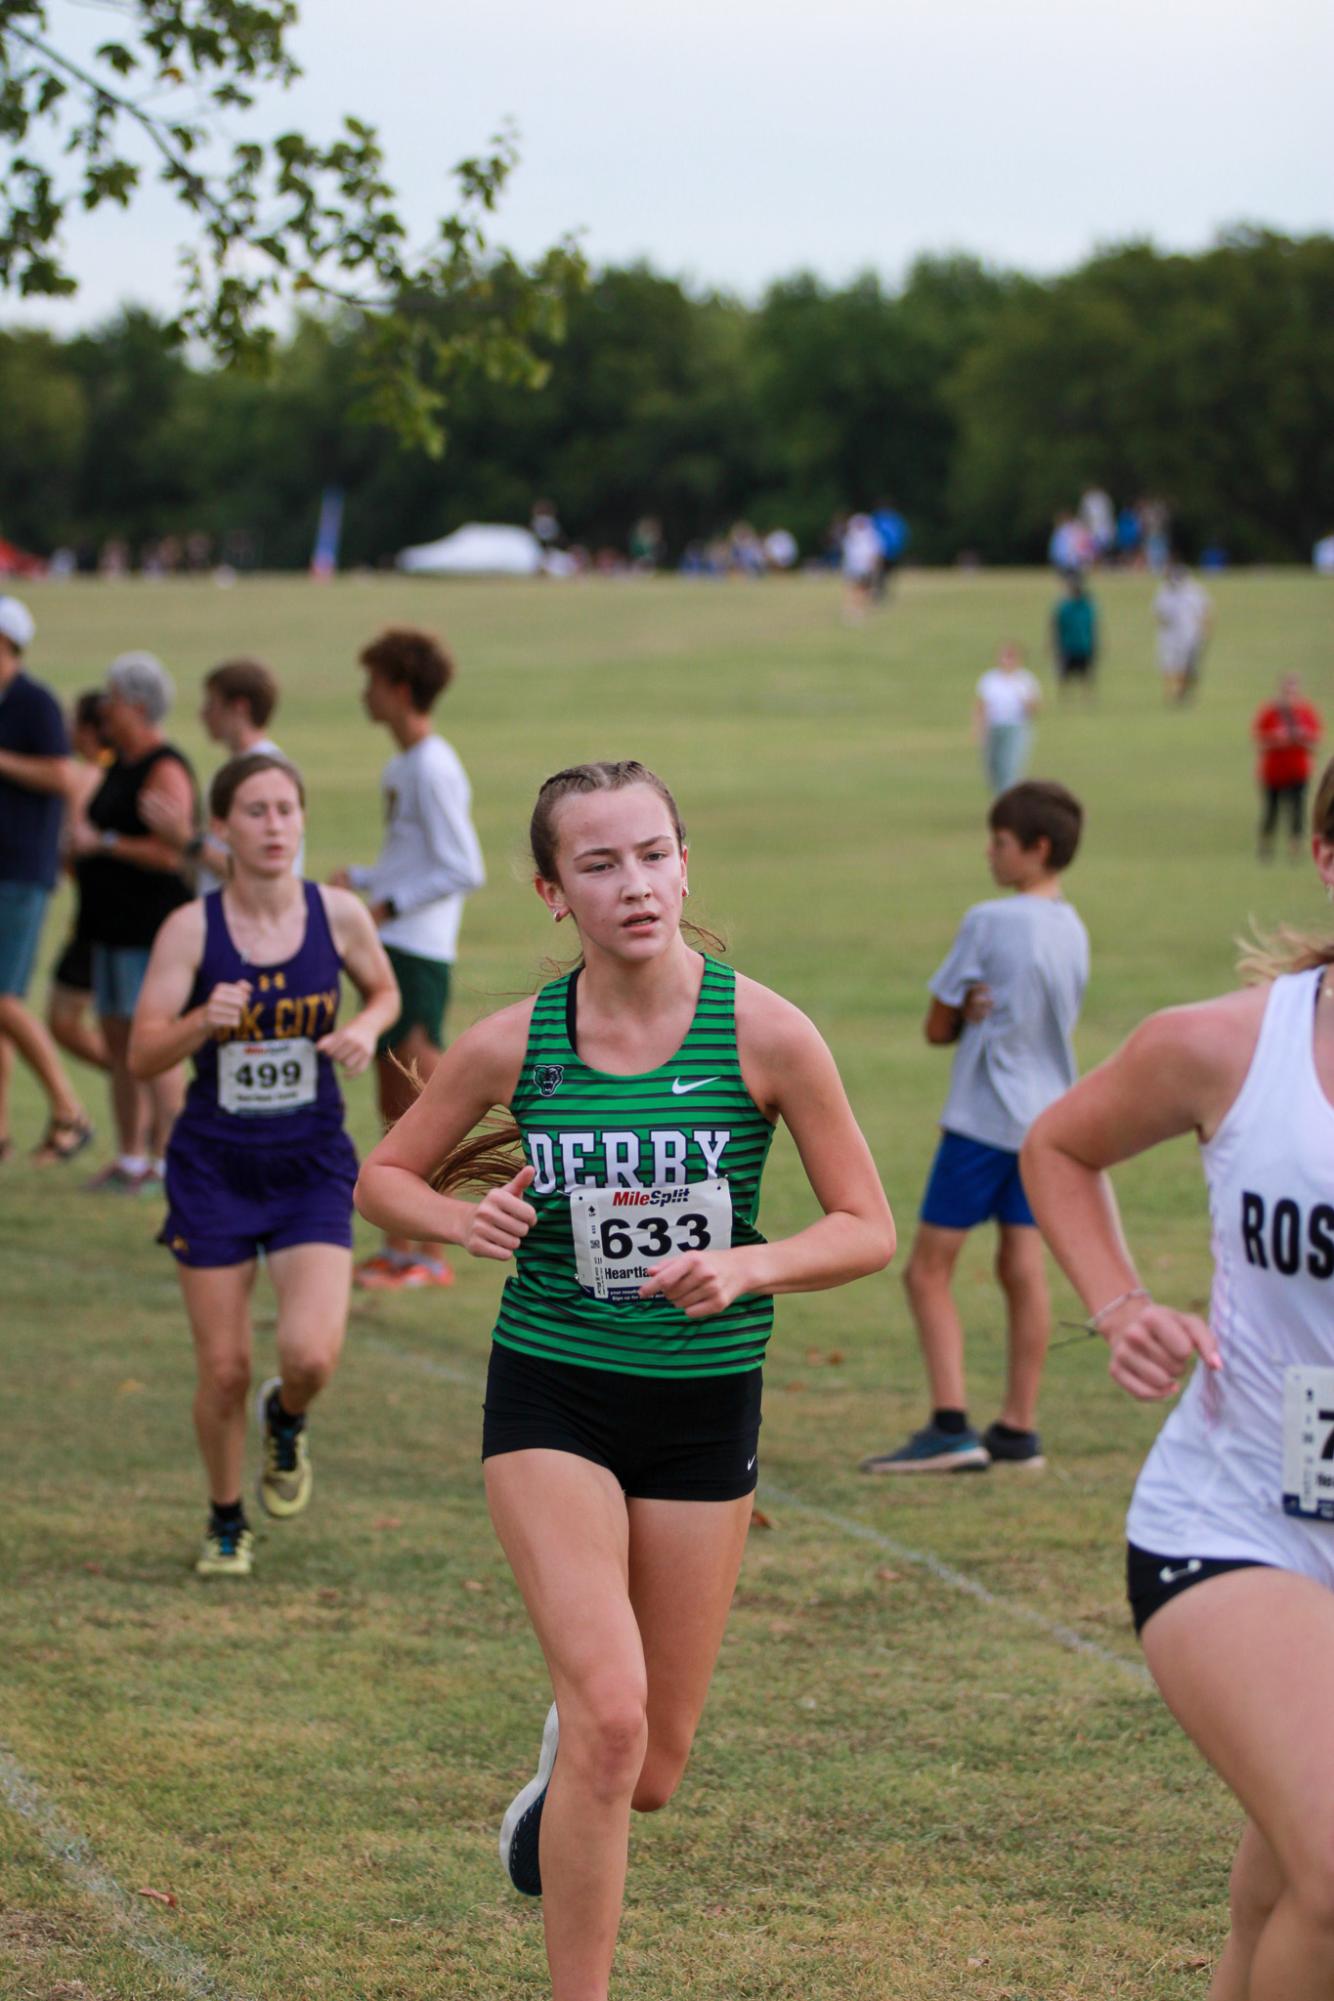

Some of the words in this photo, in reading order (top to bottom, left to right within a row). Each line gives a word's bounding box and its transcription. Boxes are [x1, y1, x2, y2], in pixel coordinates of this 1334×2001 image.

[275, 989, 336, 1039] CITY
[235, 1060, 302, 1089] 499
[527, 1129, 732, 1195] DERBY
[612, 1187, 690, 1207] MileSplit
[600, 1213, 711, 1260] 633
[1241, 1190, 1334, 1280] ROS
